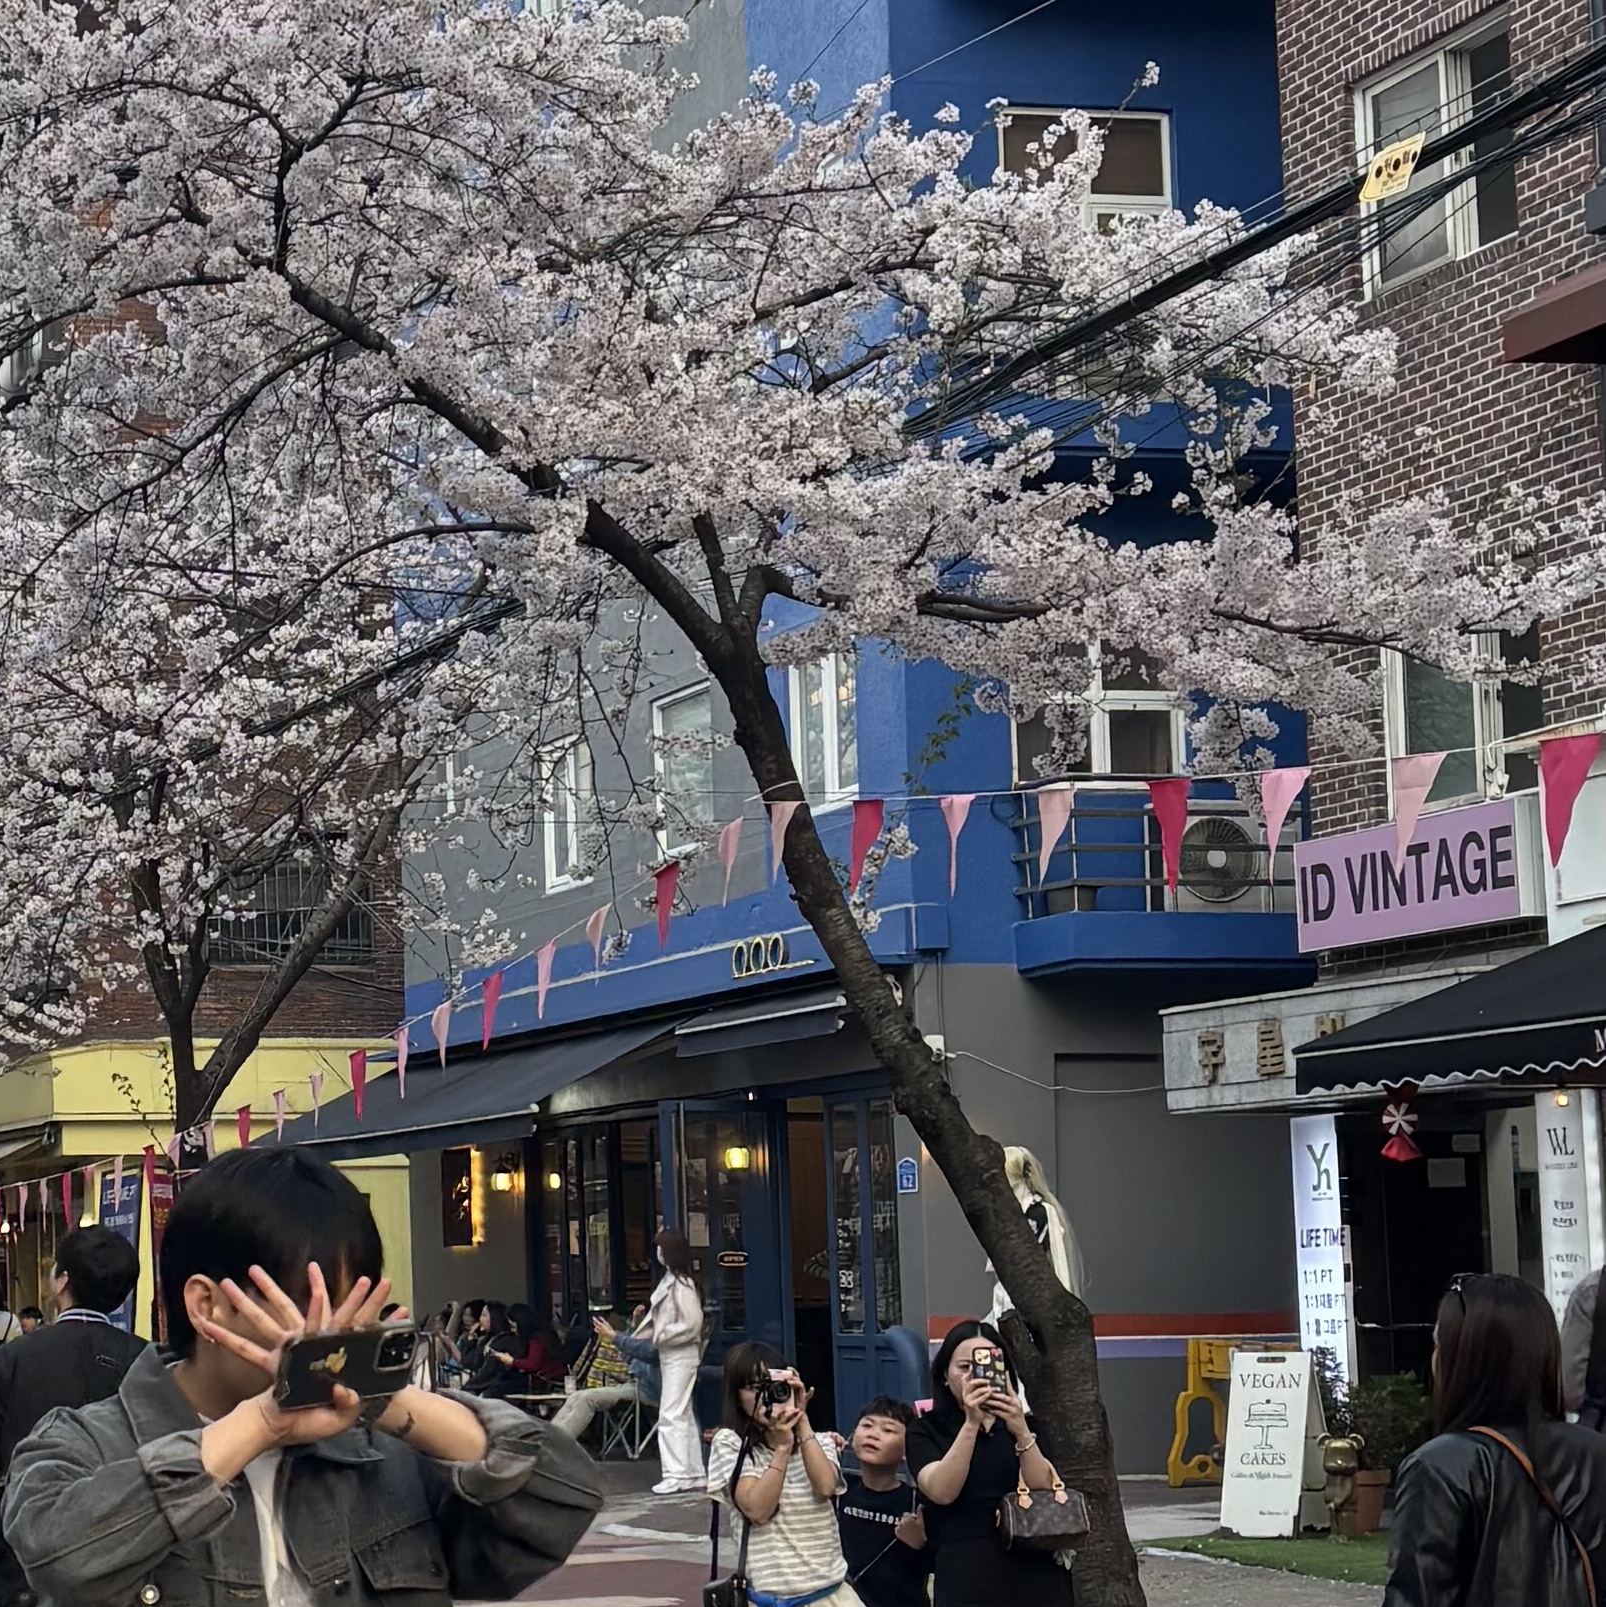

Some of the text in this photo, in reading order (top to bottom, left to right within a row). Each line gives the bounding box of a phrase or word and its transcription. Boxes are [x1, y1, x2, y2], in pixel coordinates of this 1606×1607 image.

[1300, 825, 1516, 925] ID VINTAGE
[1300, 1228, 1321, 1248] LIFE
[1239, 1373, 1302, 1389] VEGAN
[1240, 1452, 1287, 1466] CAKES
